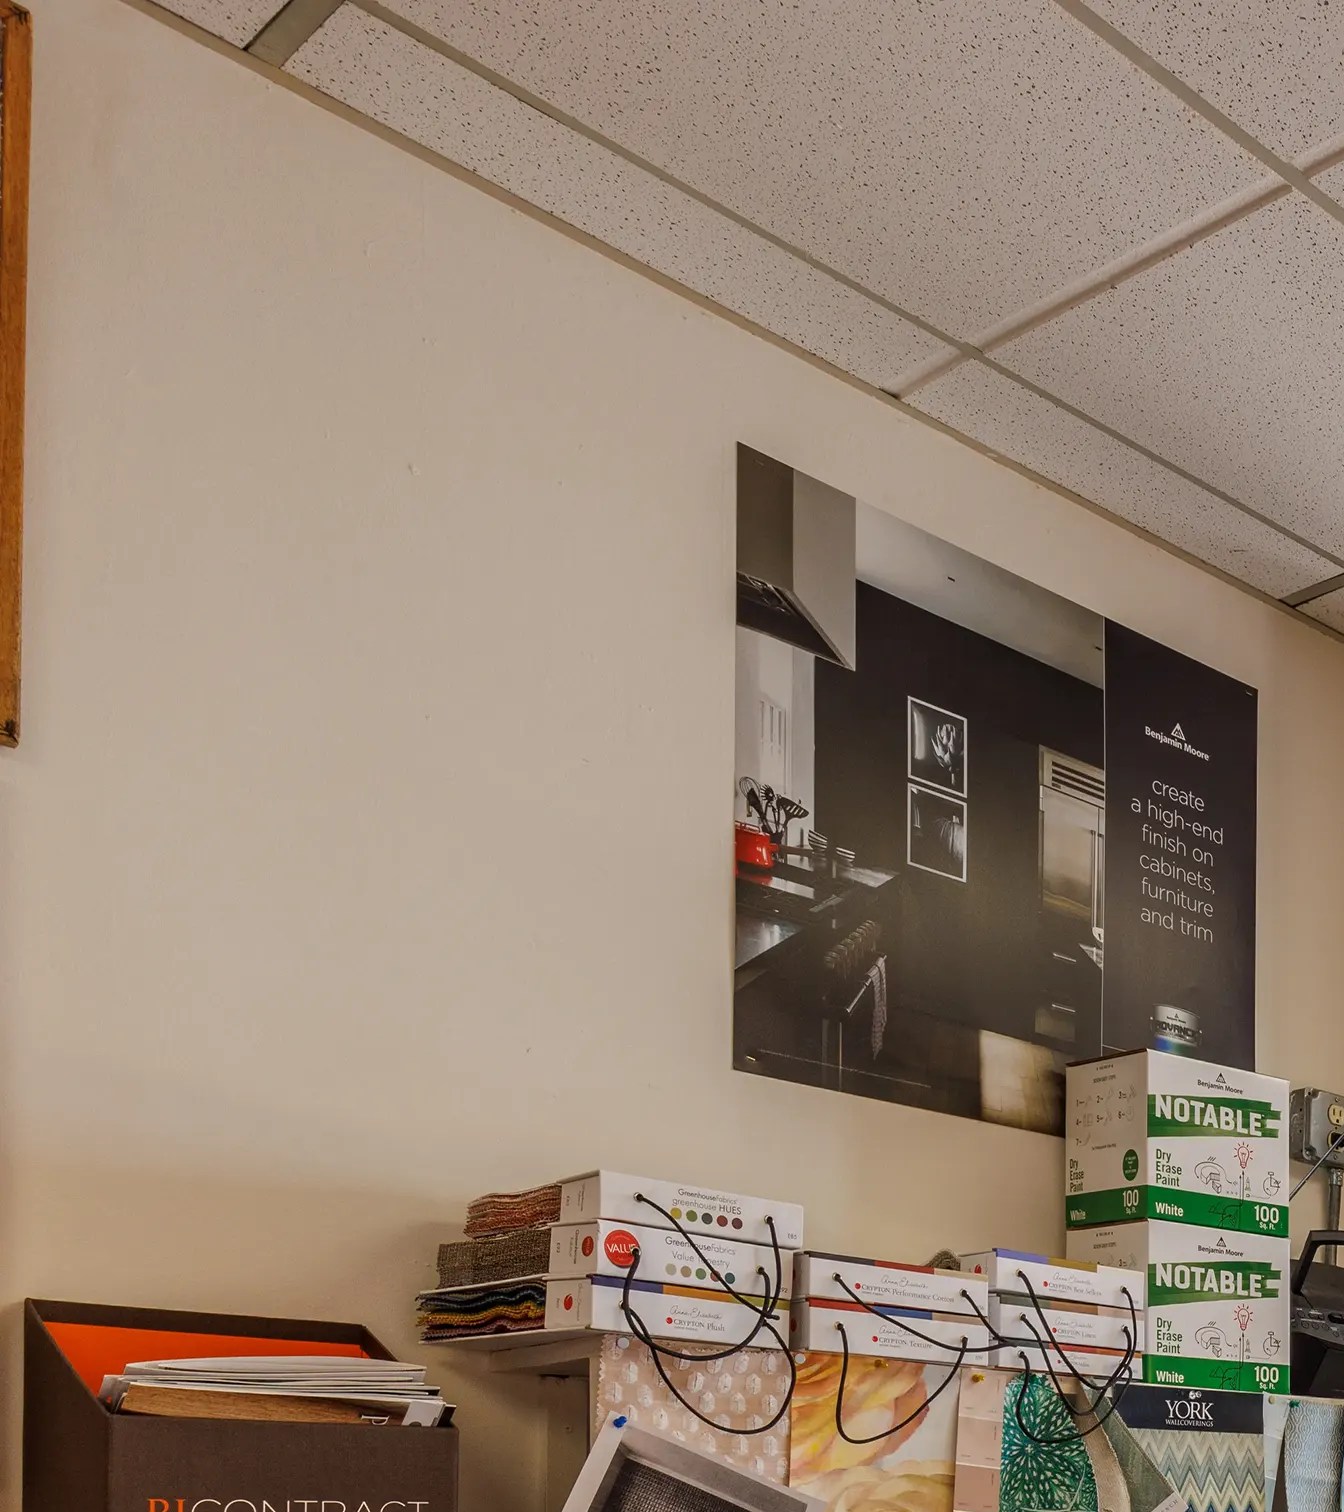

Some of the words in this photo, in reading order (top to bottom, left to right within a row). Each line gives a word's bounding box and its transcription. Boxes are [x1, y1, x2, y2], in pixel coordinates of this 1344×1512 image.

[1145, 726, 1182, 750] Benjamin
[1184, 743, 1209, 761] Moore
[1152, 780, 1204, 812] create
[1131, 798, 1140, 812] a
[1148, 800, 1223, 845] high-end
[1142, 824, 1186, 856] finish
[1193, 848, 1213, 866] on
[1140, 854, 1215, 894] cabinets,
[1142, 877, 1213, 917] furniture
[1141, 908, 1173, 930] and
[1180, 917, 1213, 943] trim
[1198, 1079, 1223, 1091] Benjamin
[1225, 1086, 1243, 1094] Moore
[1155, 1095, 1262, 1136] NOTABLE
[1156, 1149, 1171, 1163] Dry
[1070, 1159, 1078, 1169] Dry
[1156, 1161, 1182, 1175] Erase
[1070, 1170, 1084, 1181] Erase
[1156, 1173, 1179, 1187] Paint
[1070, 1182, 1083, 1192] Paint
[719, 1206, 742, 1215] HUES
[1070, 1210, 1086, 1220] White
[1123, 1190, 1138, 1207] 100
[1155, 1202, 1183, 1216] White
[1255, 1205, 1279, 1223] 100
[1198, 1245, 1224, 1257] Benjamin
[1226, 1249, 1243, 1257] Moore
[1156, 1263, 1262, 1297] NOTABLE
[892, 1289, 931, 1300] Performance
[707, 1322, 725, 1331] Plush
[1157, 1317, 1172, 1331] Dry
[1157, 1330, 1182, 1342] Erase
[909, 1340, 932, 1349] Texture
[1157, 1342, 1180, 1354] Paint
[1156, 1371, 1184, 1383] White
[1254, 1366, 1279, 1382] 100
[1165, 1400, 1213, 1420] YORK
[1165, 1419, 1213, 1427] WALLCOVERINGS
